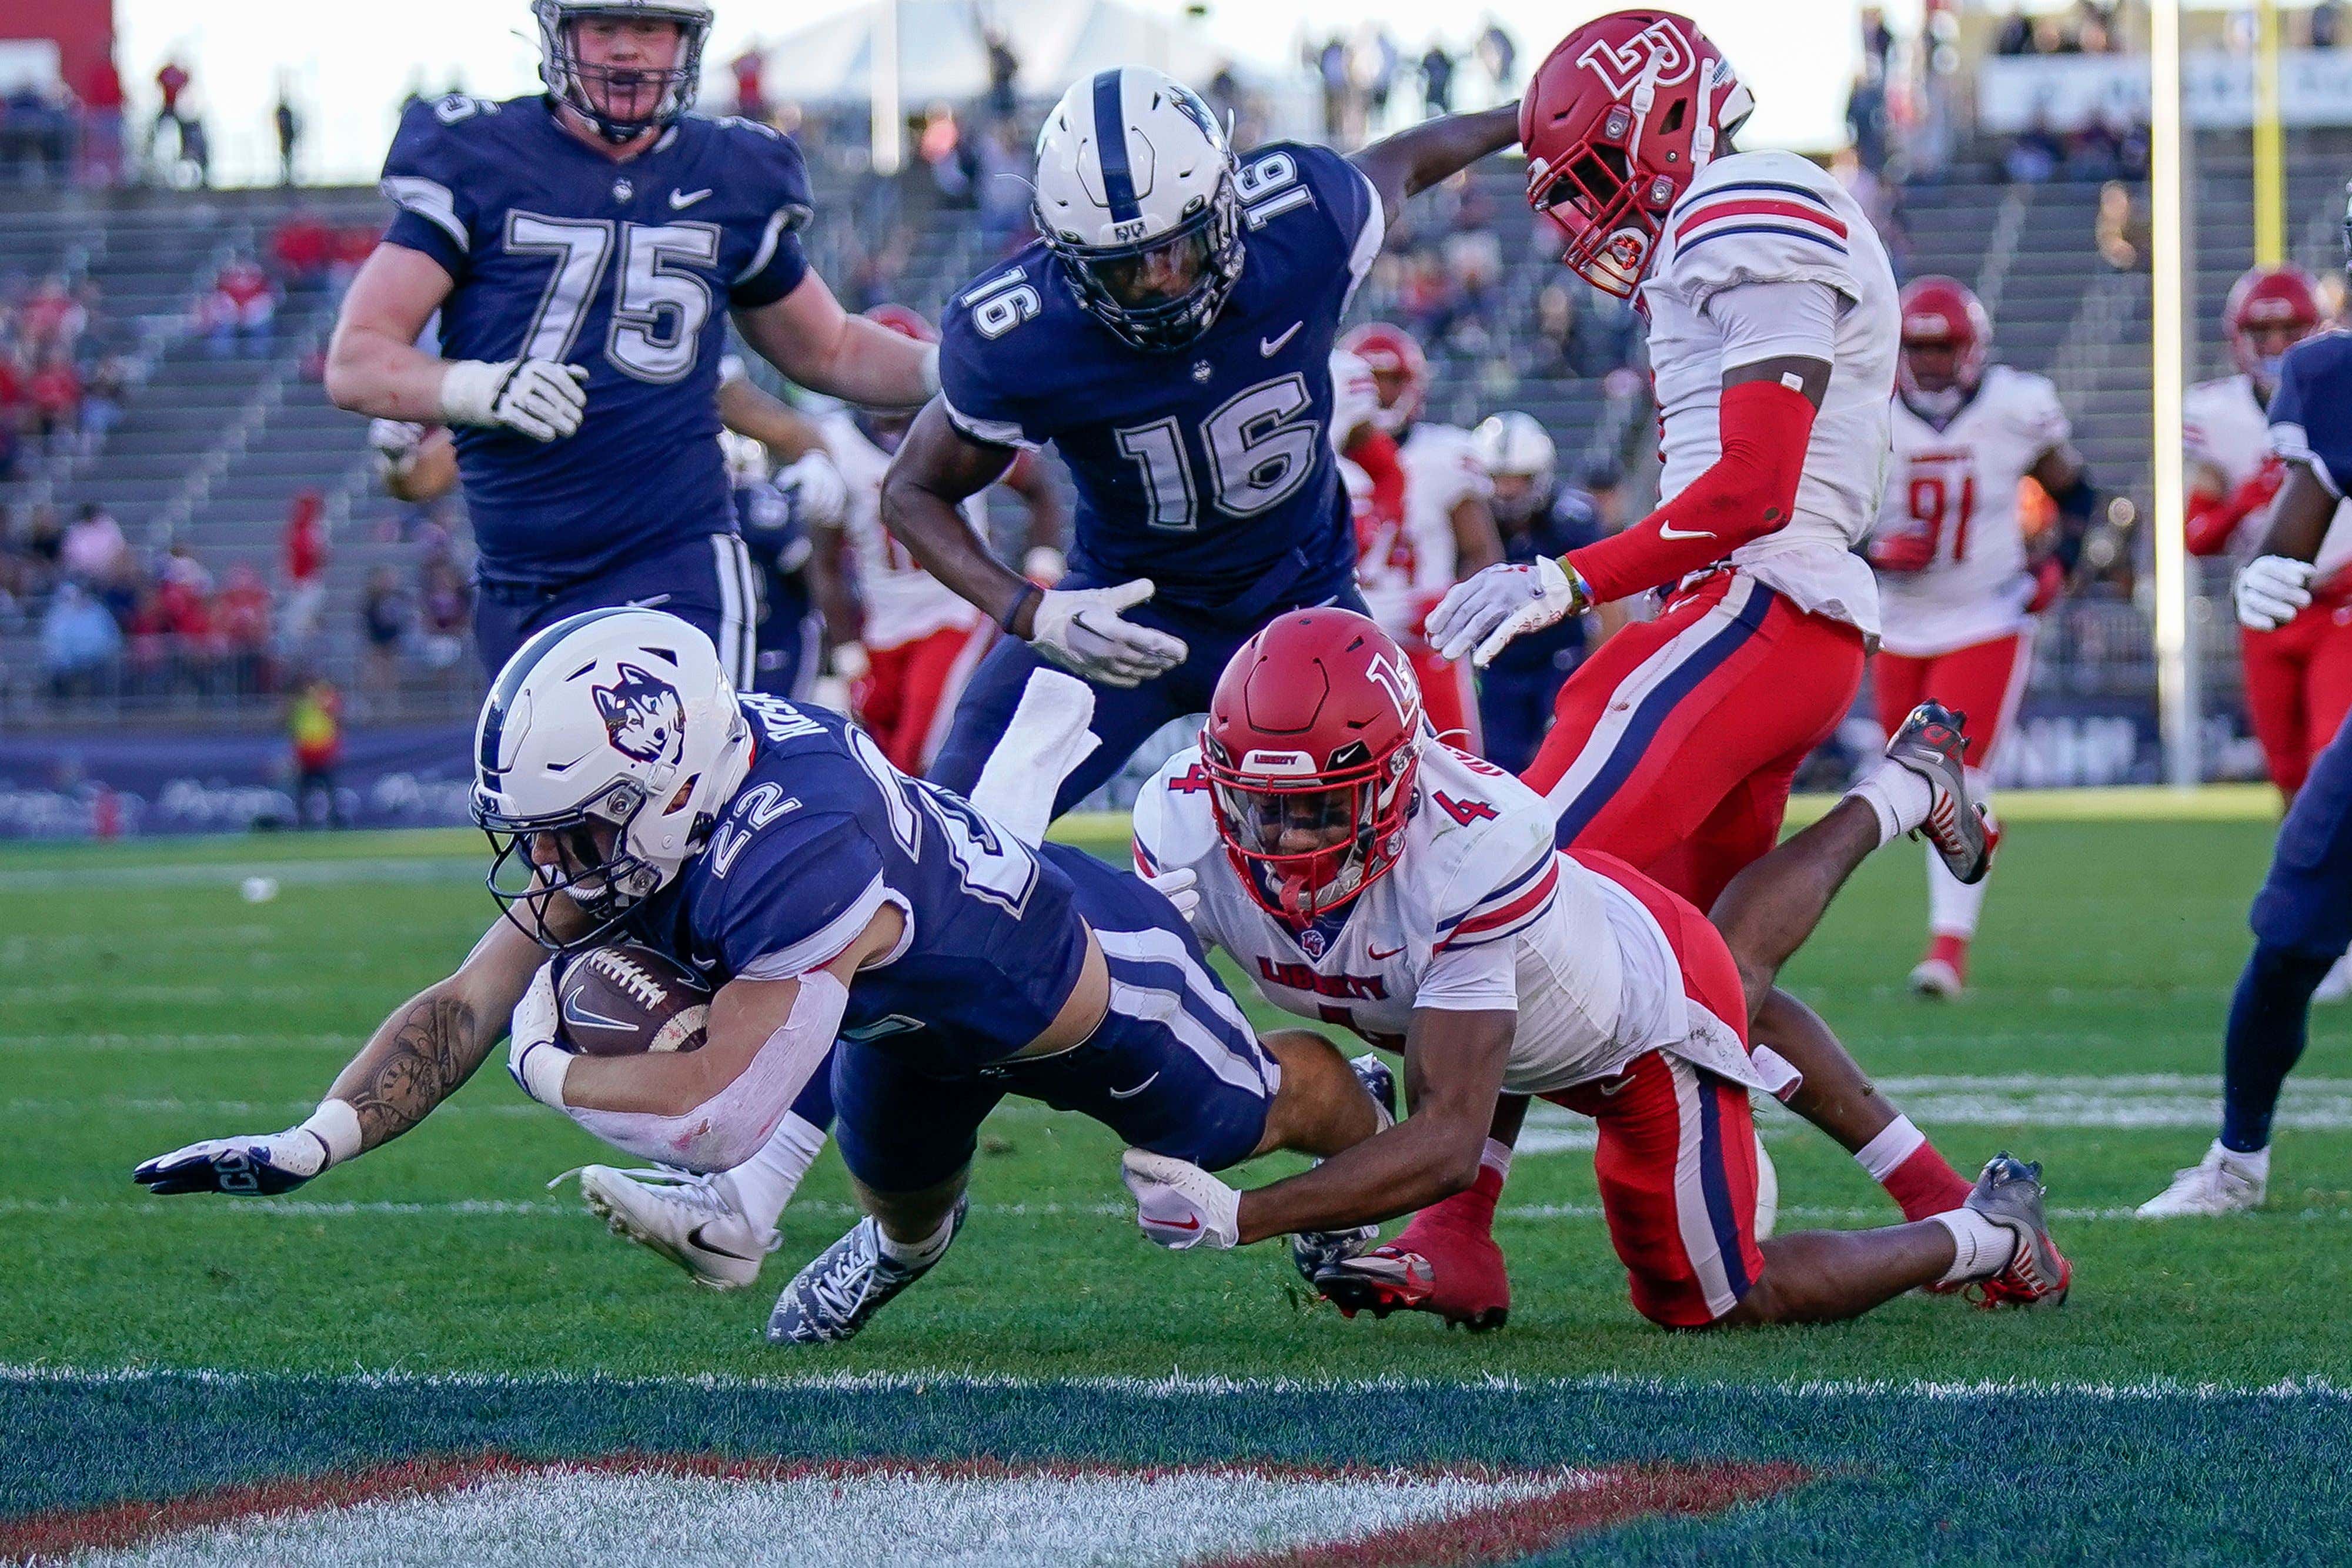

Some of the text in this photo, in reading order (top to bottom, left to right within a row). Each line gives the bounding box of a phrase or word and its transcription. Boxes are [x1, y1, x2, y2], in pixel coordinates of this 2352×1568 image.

[1234, 151, 1315, 232] 16
[503, 208, 723, 385] 75
[959, 265, 1042, 340] 16
[1115, 372, 1319, 531] 16
[1909, 477, 1973, 562] 91
[1168, 763, 1209, 794] 4
[1432, 790, 1501, 828] 4
[699, 781, 803, 880] 22
[1256, 955, 1390, 1001] LIBERTY
